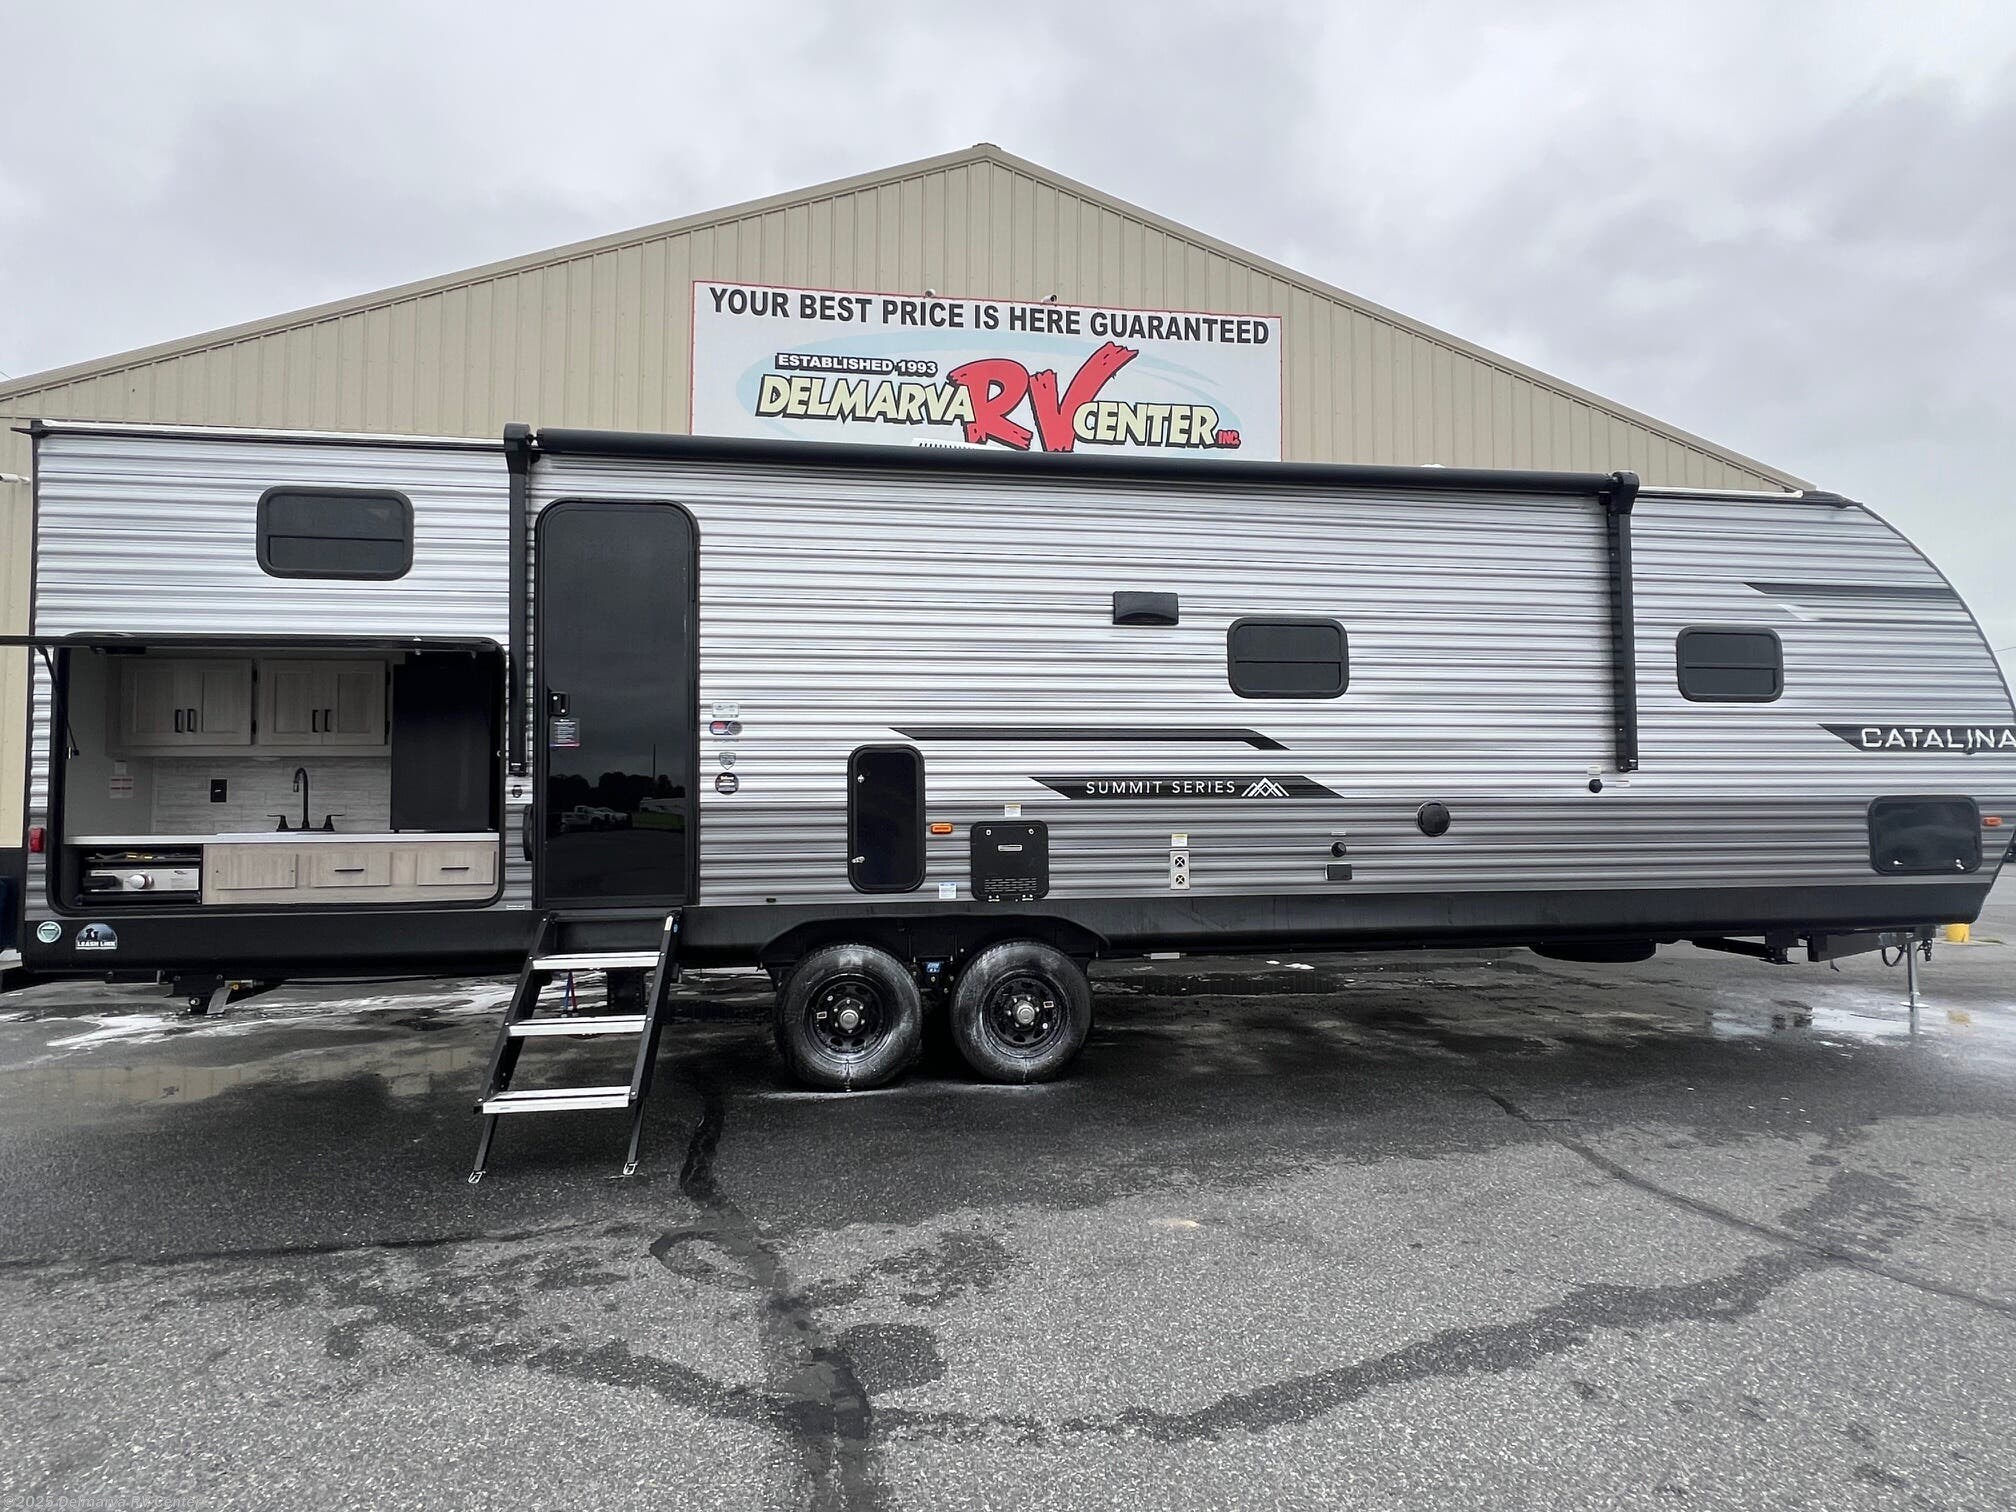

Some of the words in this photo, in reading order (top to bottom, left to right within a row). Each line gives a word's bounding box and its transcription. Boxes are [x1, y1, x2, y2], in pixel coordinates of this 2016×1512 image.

[709, 287, 790, 318] YOUR
[799, 294, 872, 323] BEST
[882, 300, 964, 328] PRICE
[974, 304, 999, 330] IS
[1009, 306, 1081, 334] HERE
[1090, 312, 1269, 345] GUARANTEED
[777, 354, 894, 373] ESTABLISHED
[897, 360, 938, 375] 1993
[757, 374, 977, 424] DELMARVA
[946, 341, 1139, 453] RV
[1072, 401, 1219, 447] CENTER
[1217, 430, 1241, 449] INC.
[1861, 728, 2016, 749] CATALINA
[1085, 780, 1163, 795] SUMMIT
[1172, 780, 1236, 794] SERIES
